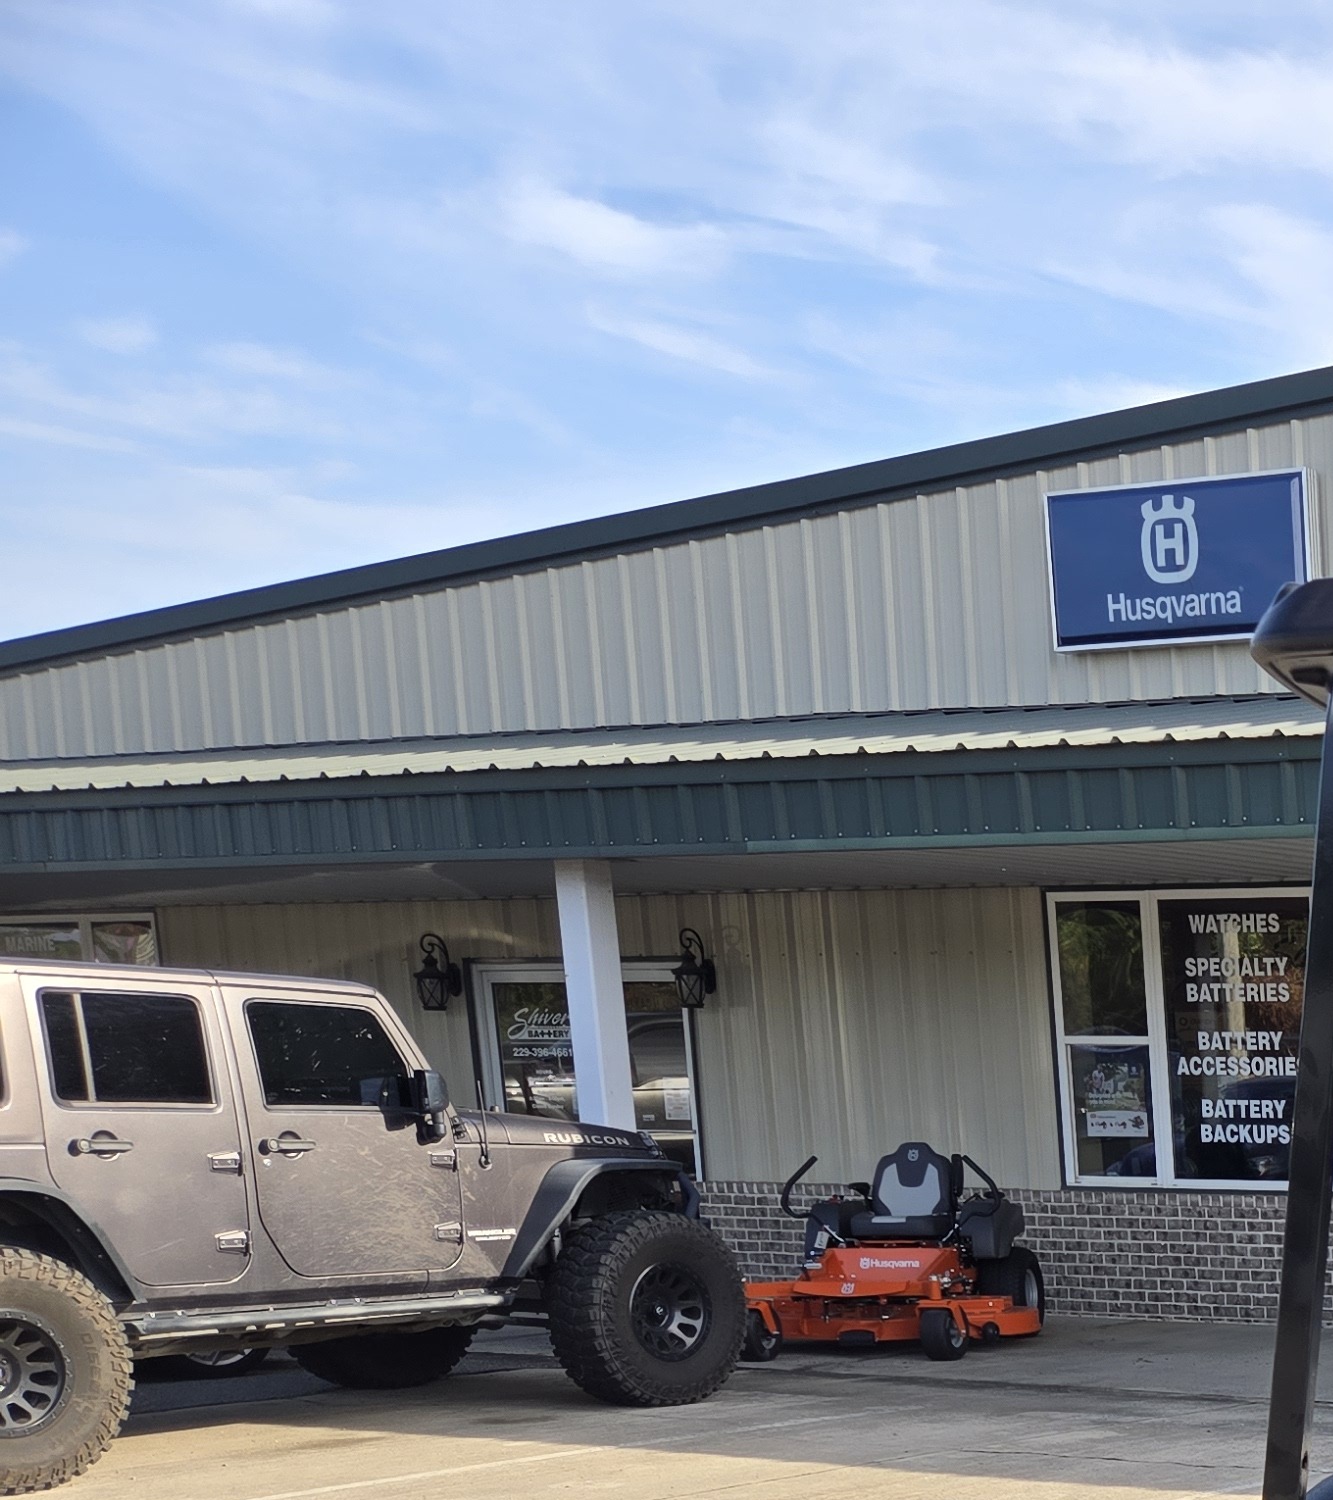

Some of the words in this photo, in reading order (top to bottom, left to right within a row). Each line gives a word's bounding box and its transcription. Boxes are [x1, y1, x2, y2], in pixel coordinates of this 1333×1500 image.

[1107, 590, 1242, 623] Husqvarna
[1188, 913, 1280, 934] WATCHES
[1184, 957, 1289, 977] SPECIALTY
[1185, 983, 1290, 1003] BATTERIES
[1197, 1031, 1283, 1051] BATTERY
[1177, 1056, 1300, 1077] ACCESSORIE
[1201, 1099, 1287, 1119] BATTERY
[543, 1132, 630, 1146] RUBICON
[1200, 1124, 1291, 1145] BACKUPS
[870, 1258, 920, 1269] Husqvarna
